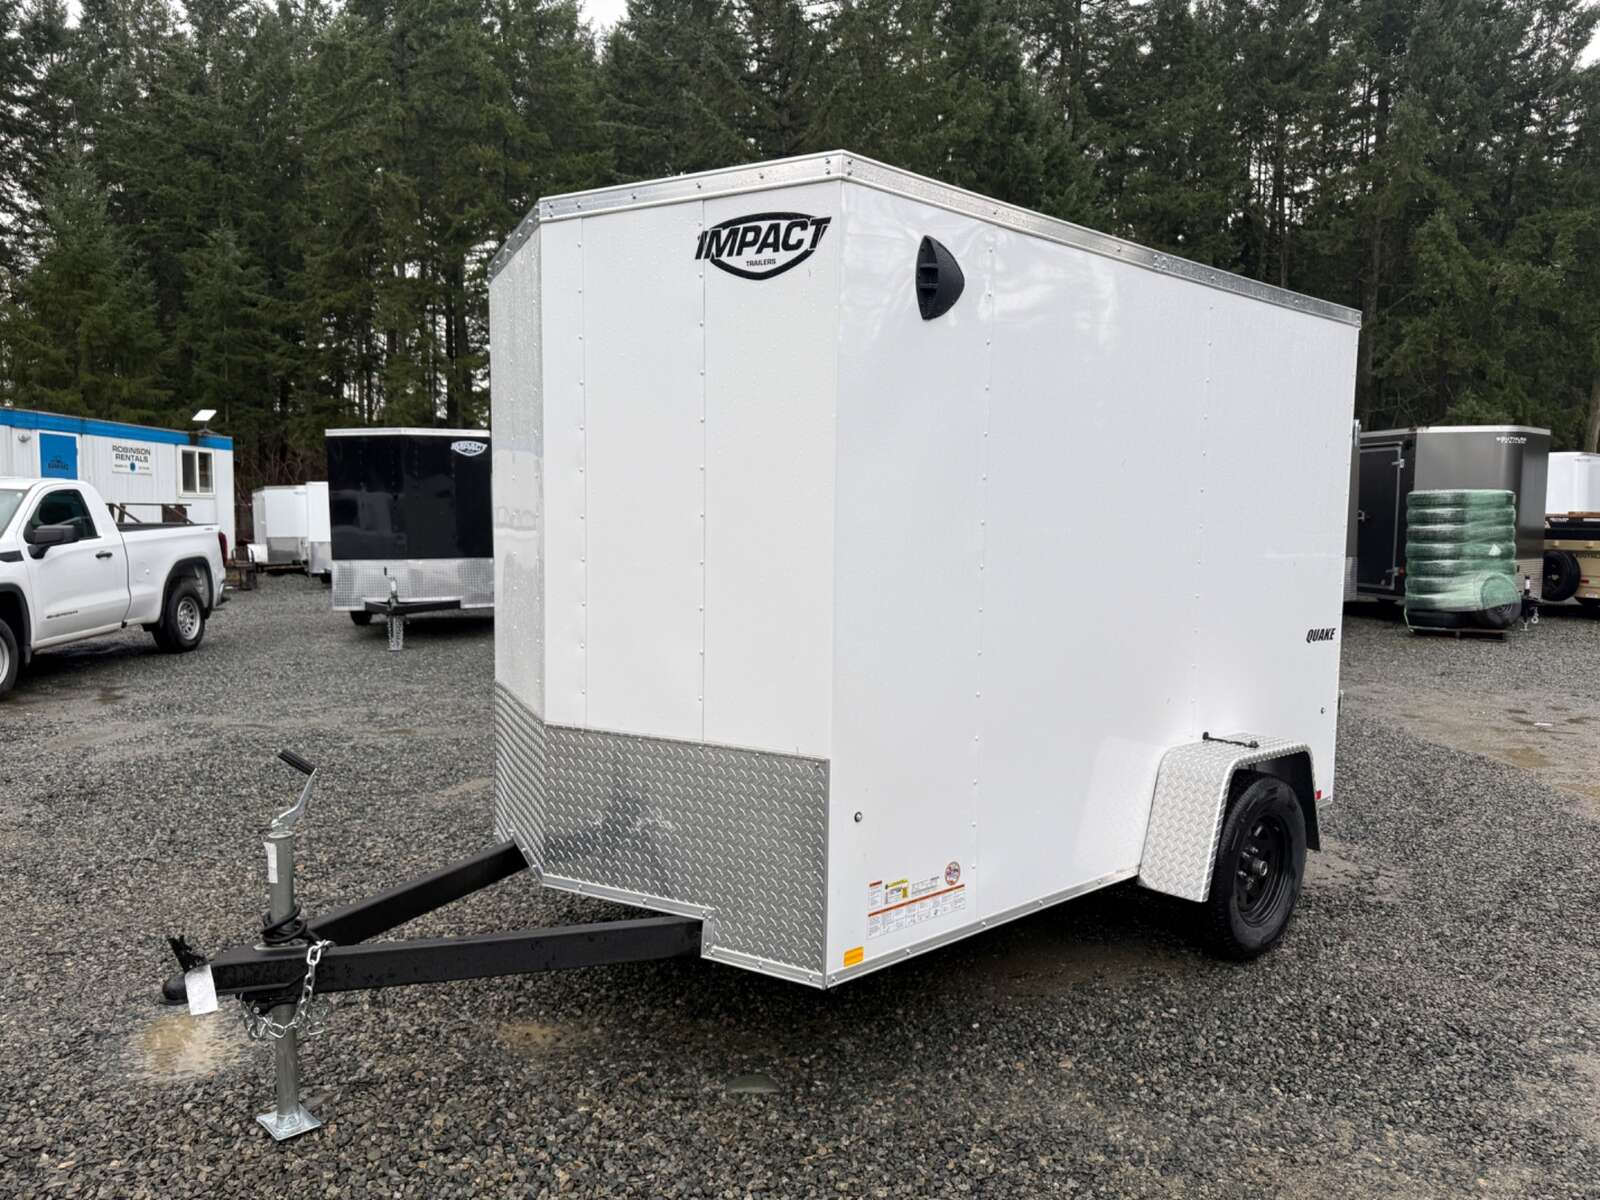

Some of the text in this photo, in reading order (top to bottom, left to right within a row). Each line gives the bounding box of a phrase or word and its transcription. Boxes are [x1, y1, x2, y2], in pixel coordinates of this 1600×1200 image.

[694, 216, 832, 260] IMPACT
[746, 257, 776, 268] TRAILERS
[112, 445, 151, 456] ROBINSON
[115, 453, 149, 463] RENTALS
[1306, 628, 1336, 643] QUAKE
